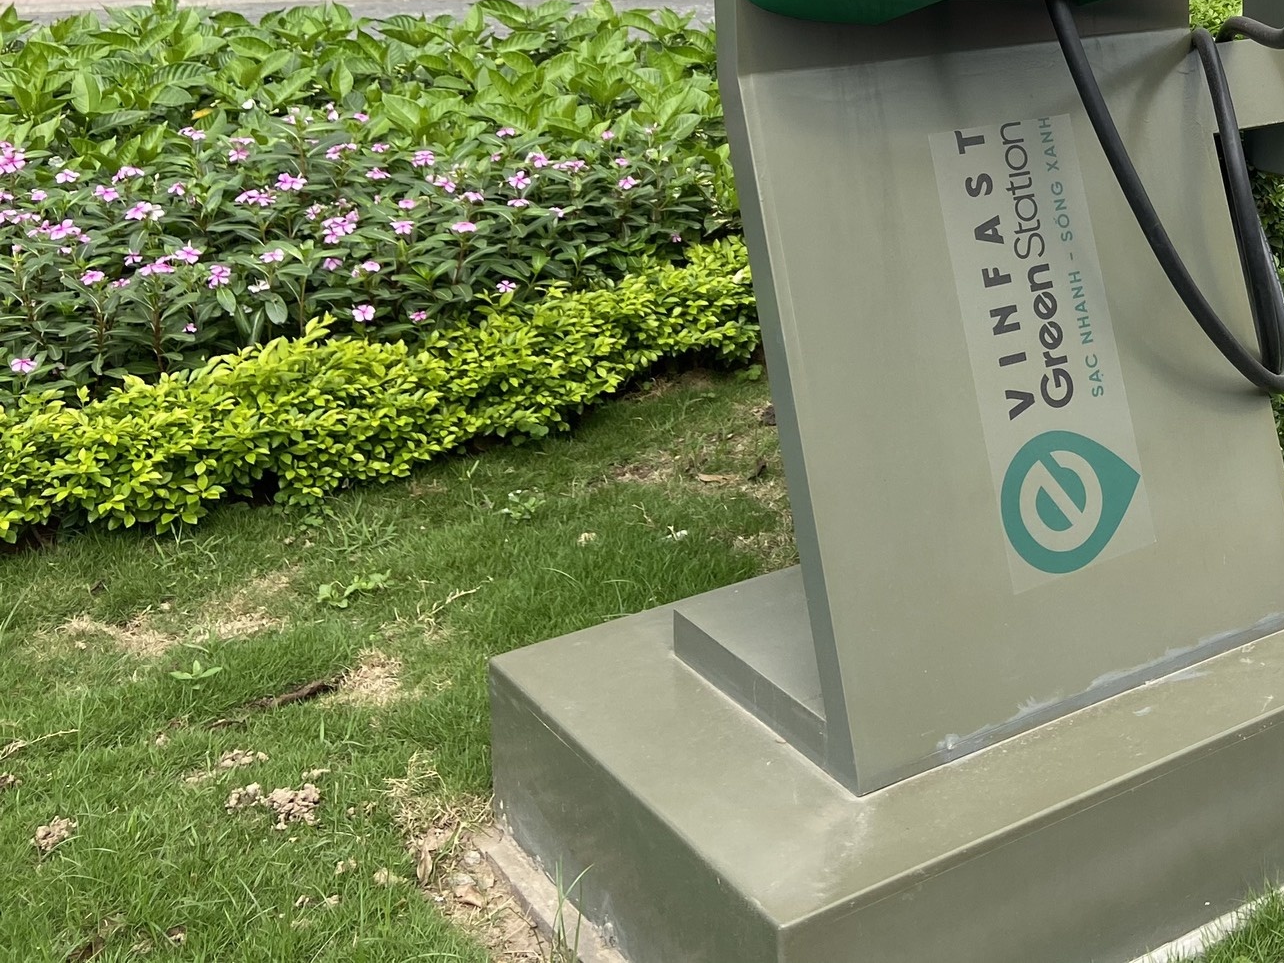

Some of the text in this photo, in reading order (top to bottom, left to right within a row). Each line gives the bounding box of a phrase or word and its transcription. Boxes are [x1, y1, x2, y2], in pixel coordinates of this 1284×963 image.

[1037, 117, 1060, 172] XANH
[1051, 181, 1074, 243] SỐNG
[954, 130, 1035, 421] VINFAST
[1067, 270, 1094, 345] NHANH
[1085, 353, 1104, 398] SẠC
